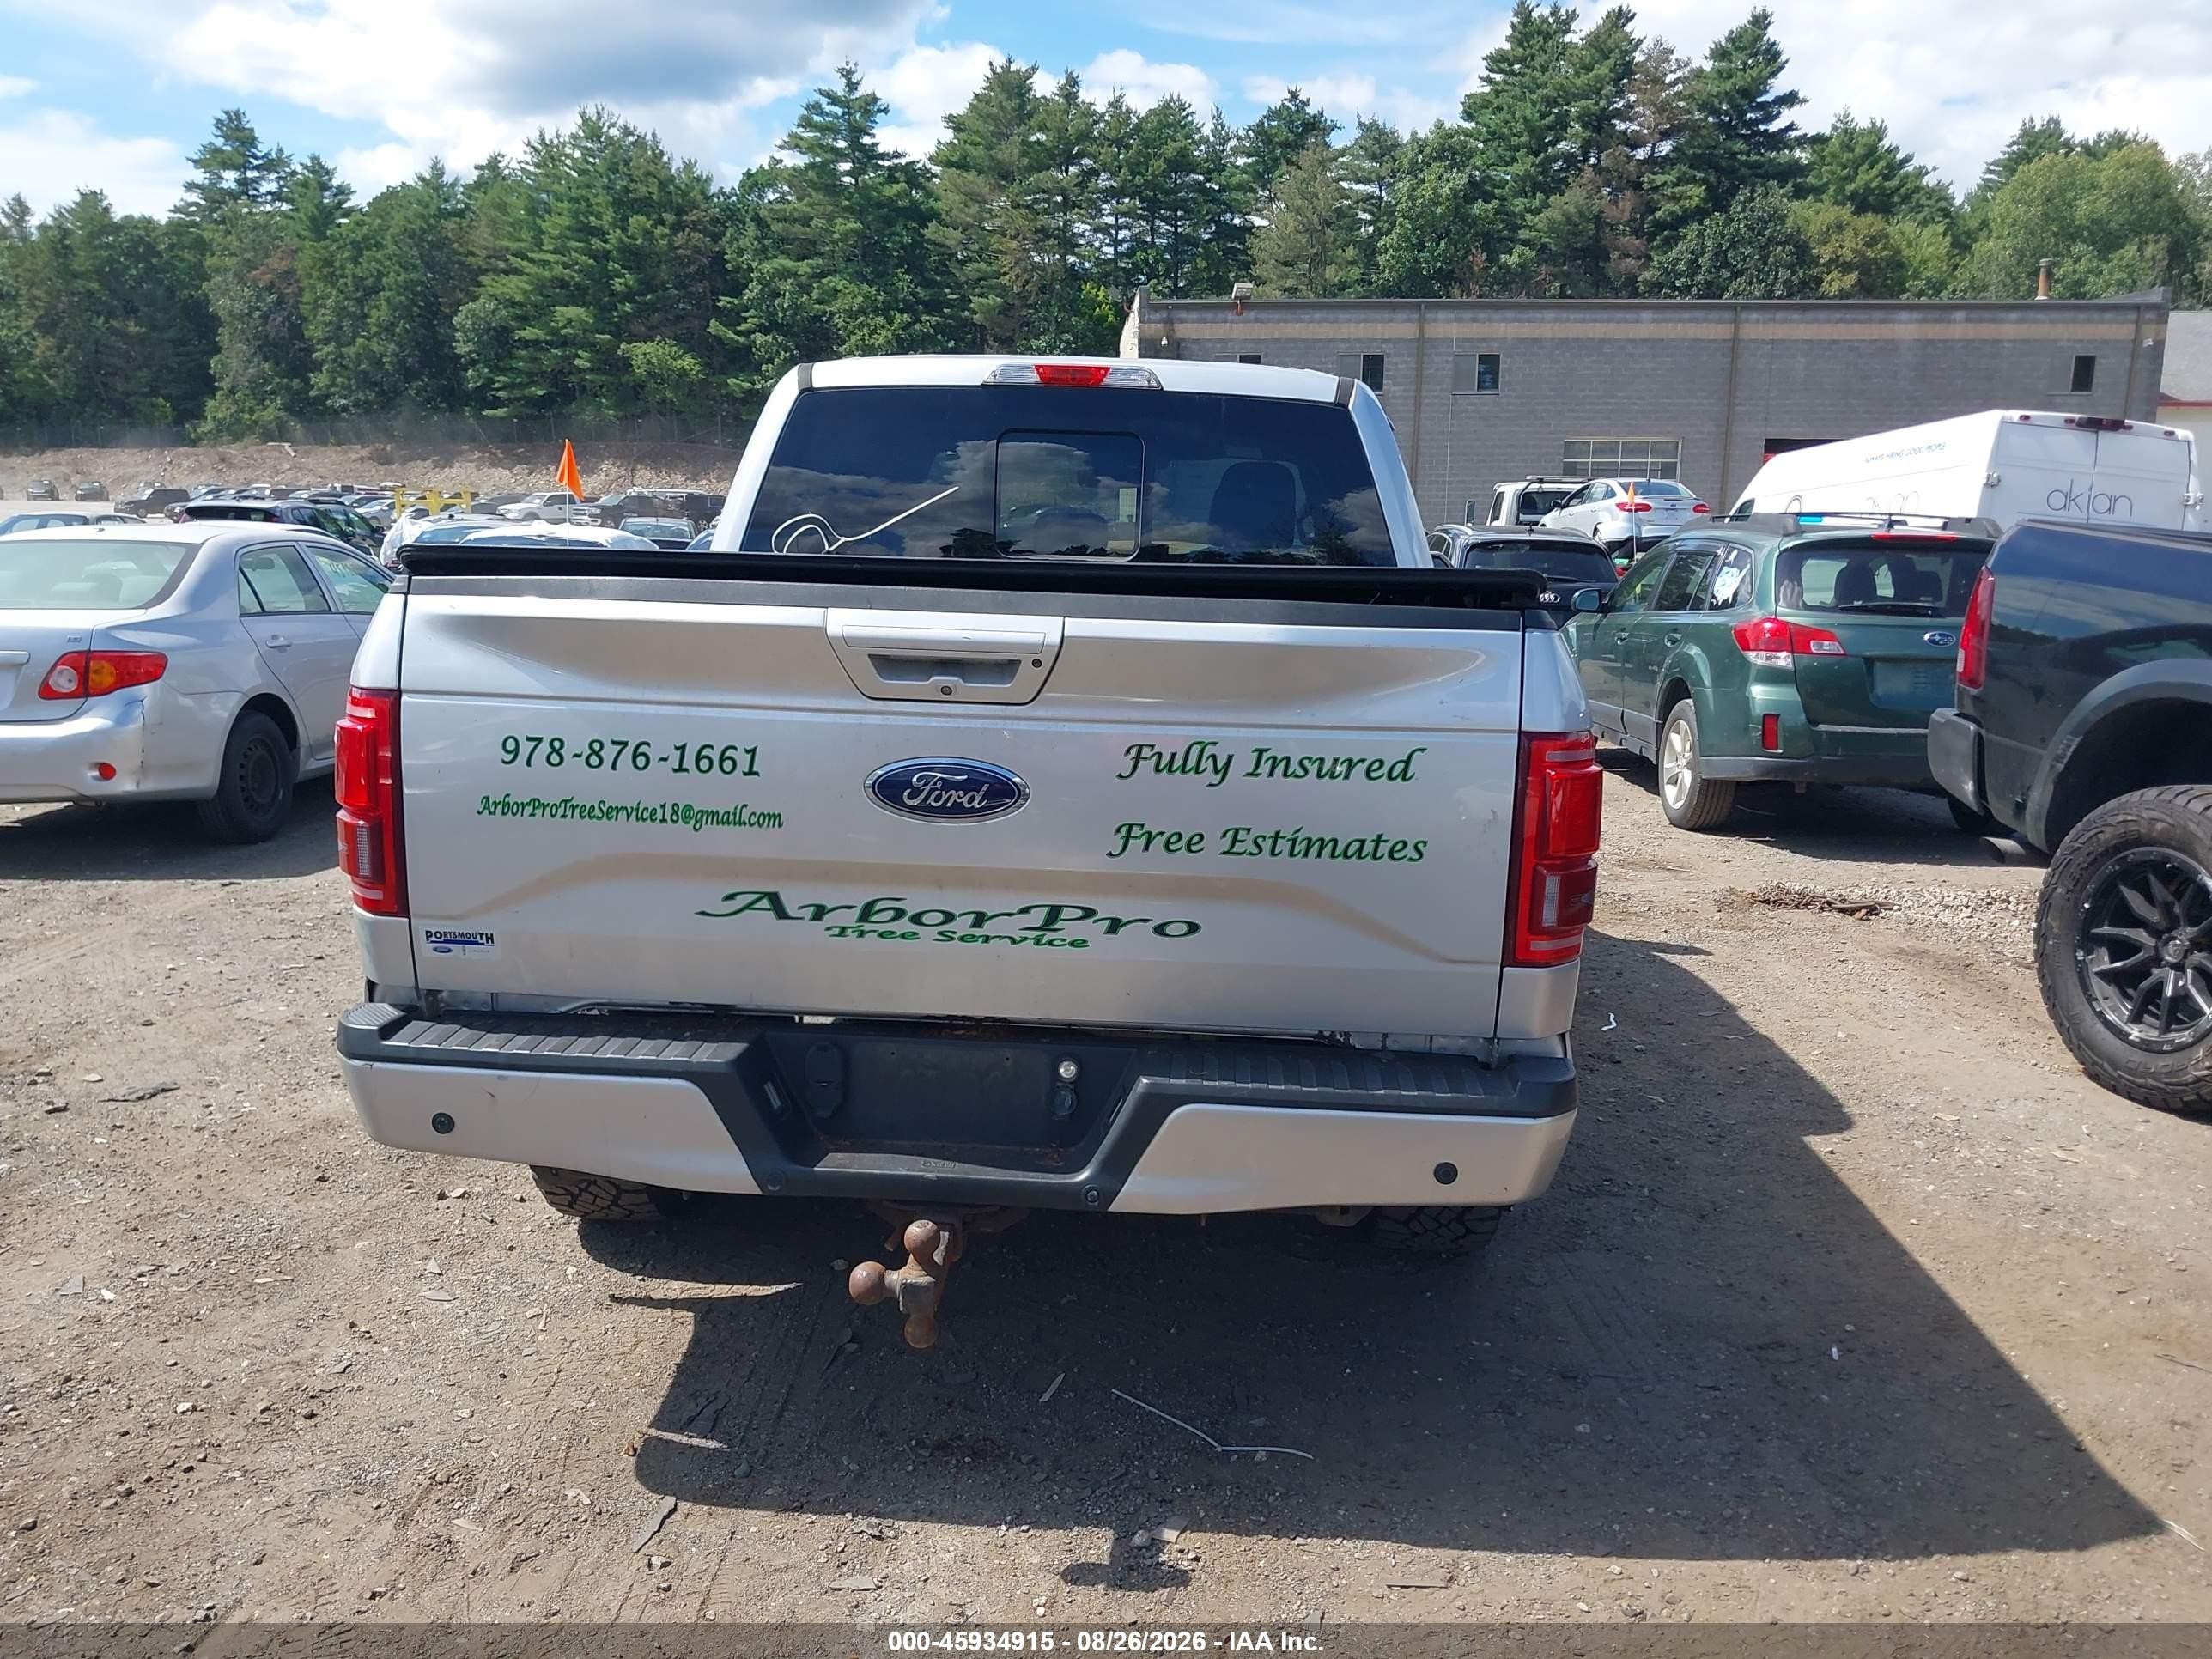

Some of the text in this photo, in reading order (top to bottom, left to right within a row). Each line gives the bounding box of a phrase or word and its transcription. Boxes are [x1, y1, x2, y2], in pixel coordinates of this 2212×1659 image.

[2046, 478, 2133, 517] akian
[501, 735, 761, 777] 978-876-1661
[1115, 740, 1428, 787] Fully Insured
[902, 771, 1010, 809] Ford
[477, 793, 785, 832] ArborProTreeService18@gmail.com
[1105, 823, 1429, 862] Free Estimates
[694, 890, 1203, 939] ArborPro
[425, 930, 495, 945] PORTSMOUTH
[824, 924, 1091, 949] Tree Service
